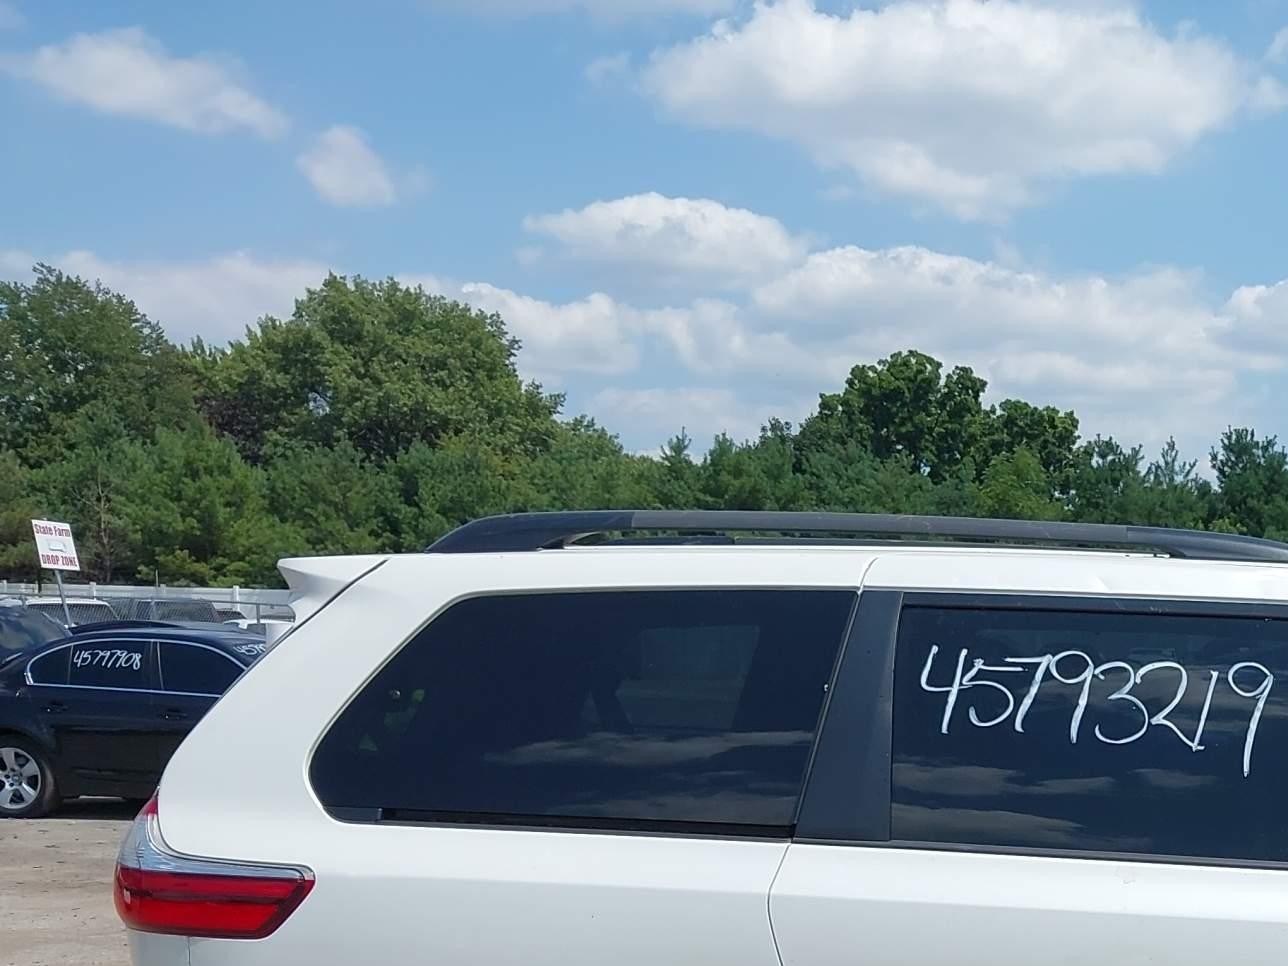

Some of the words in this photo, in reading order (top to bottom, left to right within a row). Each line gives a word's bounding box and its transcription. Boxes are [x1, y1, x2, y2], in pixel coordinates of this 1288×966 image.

[34, 523, 54, 536] State
[53, 525, 71, 537] Farm
[41, 554, 60, 565] DROP
[61, 555, 78, 567] ZONE
[73, 649, 142, 670] 45797908
[920, 645, 1274, 777] 45793219
